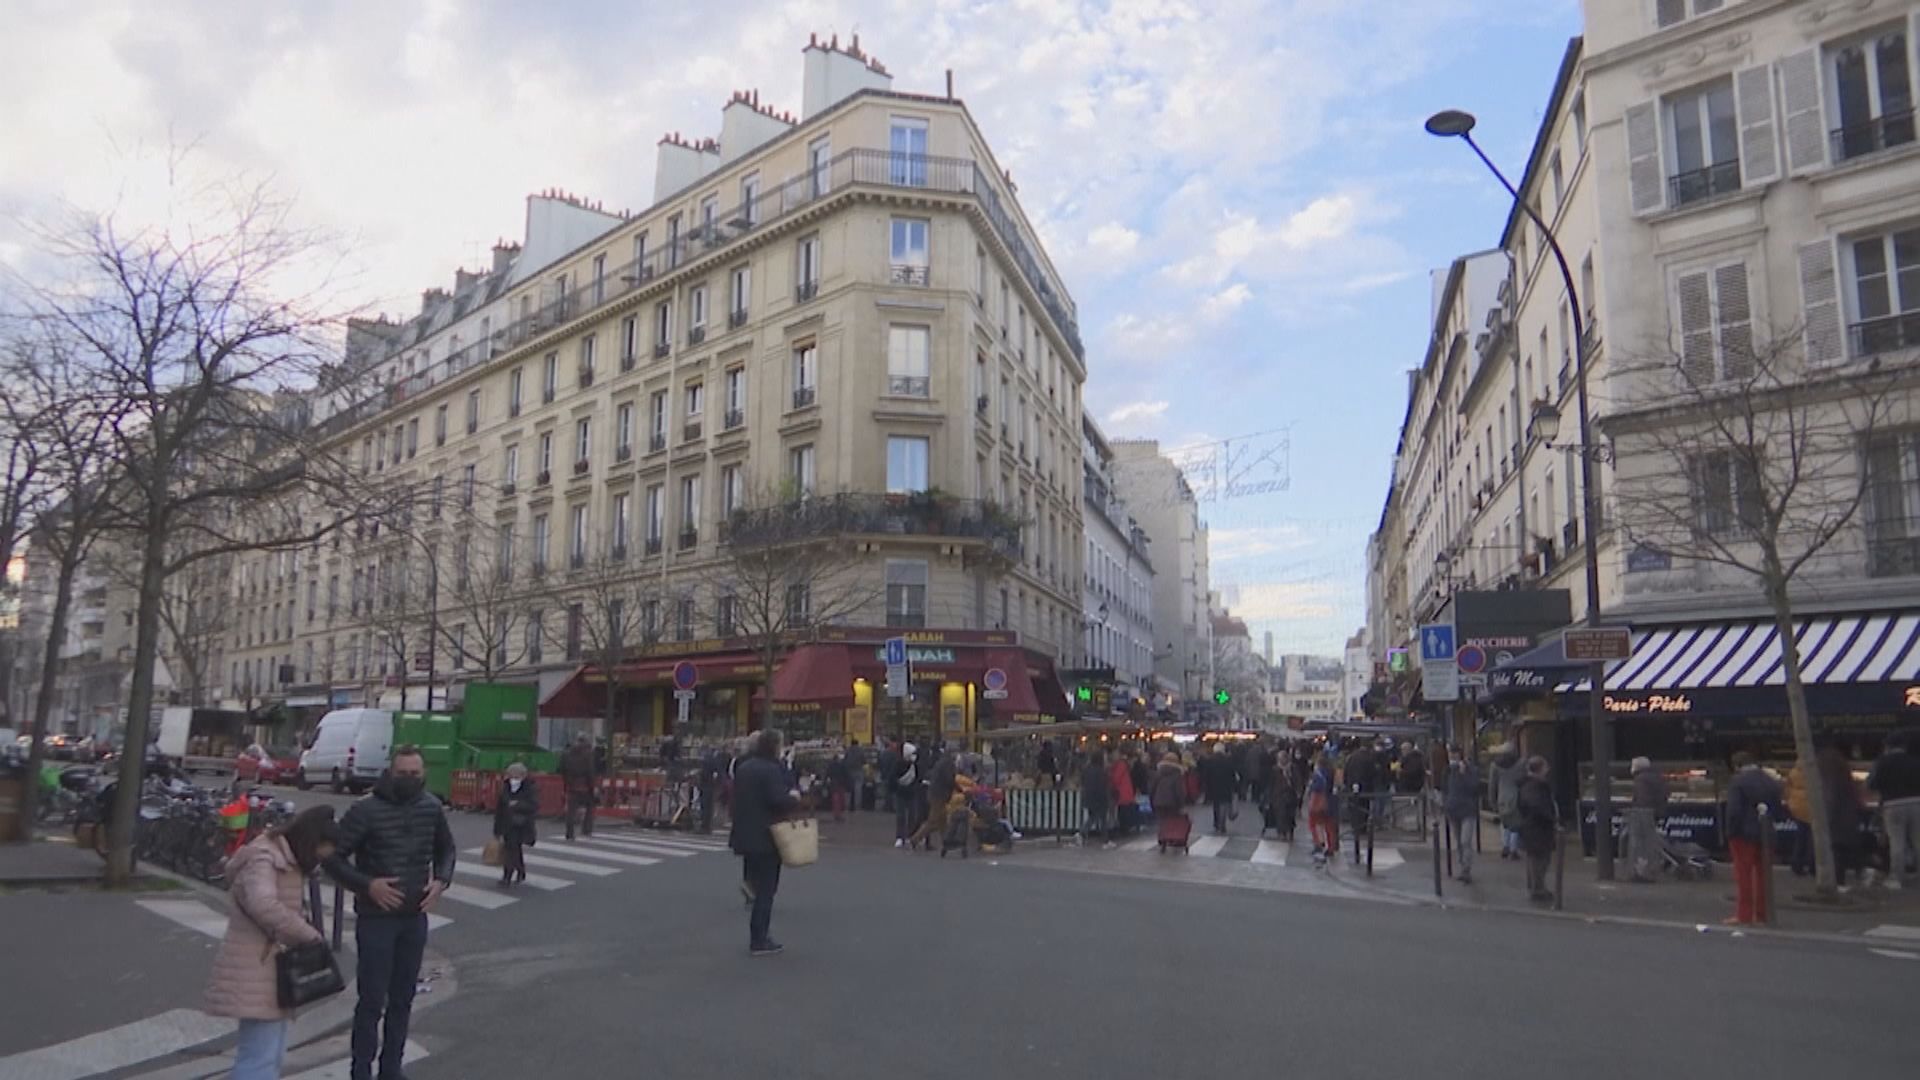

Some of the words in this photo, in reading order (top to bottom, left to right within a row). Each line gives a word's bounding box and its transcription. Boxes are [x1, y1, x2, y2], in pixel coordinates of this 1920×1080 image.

[903, 631, 945, 641] SABAH
[1466, 636, 1529, 648] BOUCHERIE
[879, 648, 952, 661] SBAH
[1514, 670, 1545, 687] Mer
[1665, 813, 1715, 829] poissons
